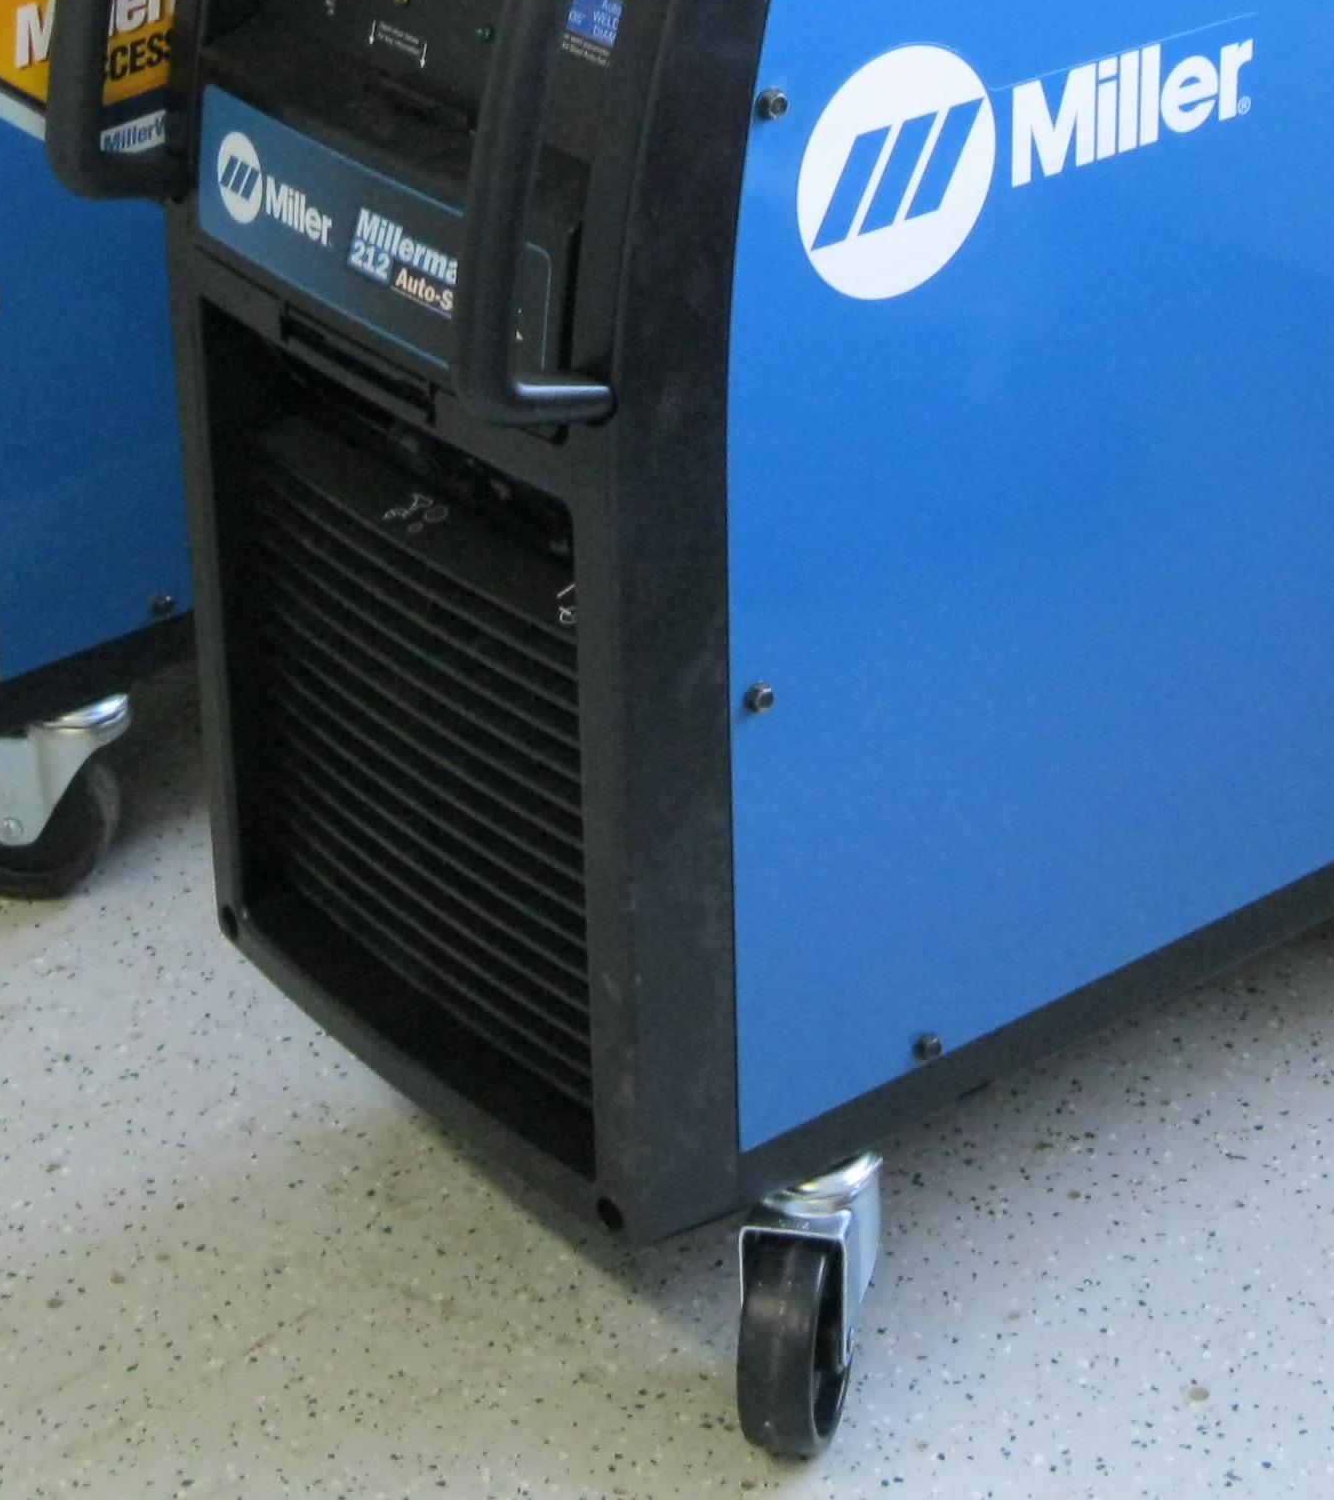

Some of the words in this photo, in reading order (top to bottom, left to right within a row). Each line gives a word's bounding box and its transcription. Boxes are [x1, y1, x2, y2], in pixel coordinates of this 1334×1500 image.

[1010, 38, 1255, 189] Miller
[266, 175, 333, 247] Miller
[349, 238, 391, 281] 212
[394, 266, 455, 312] Auto-S
